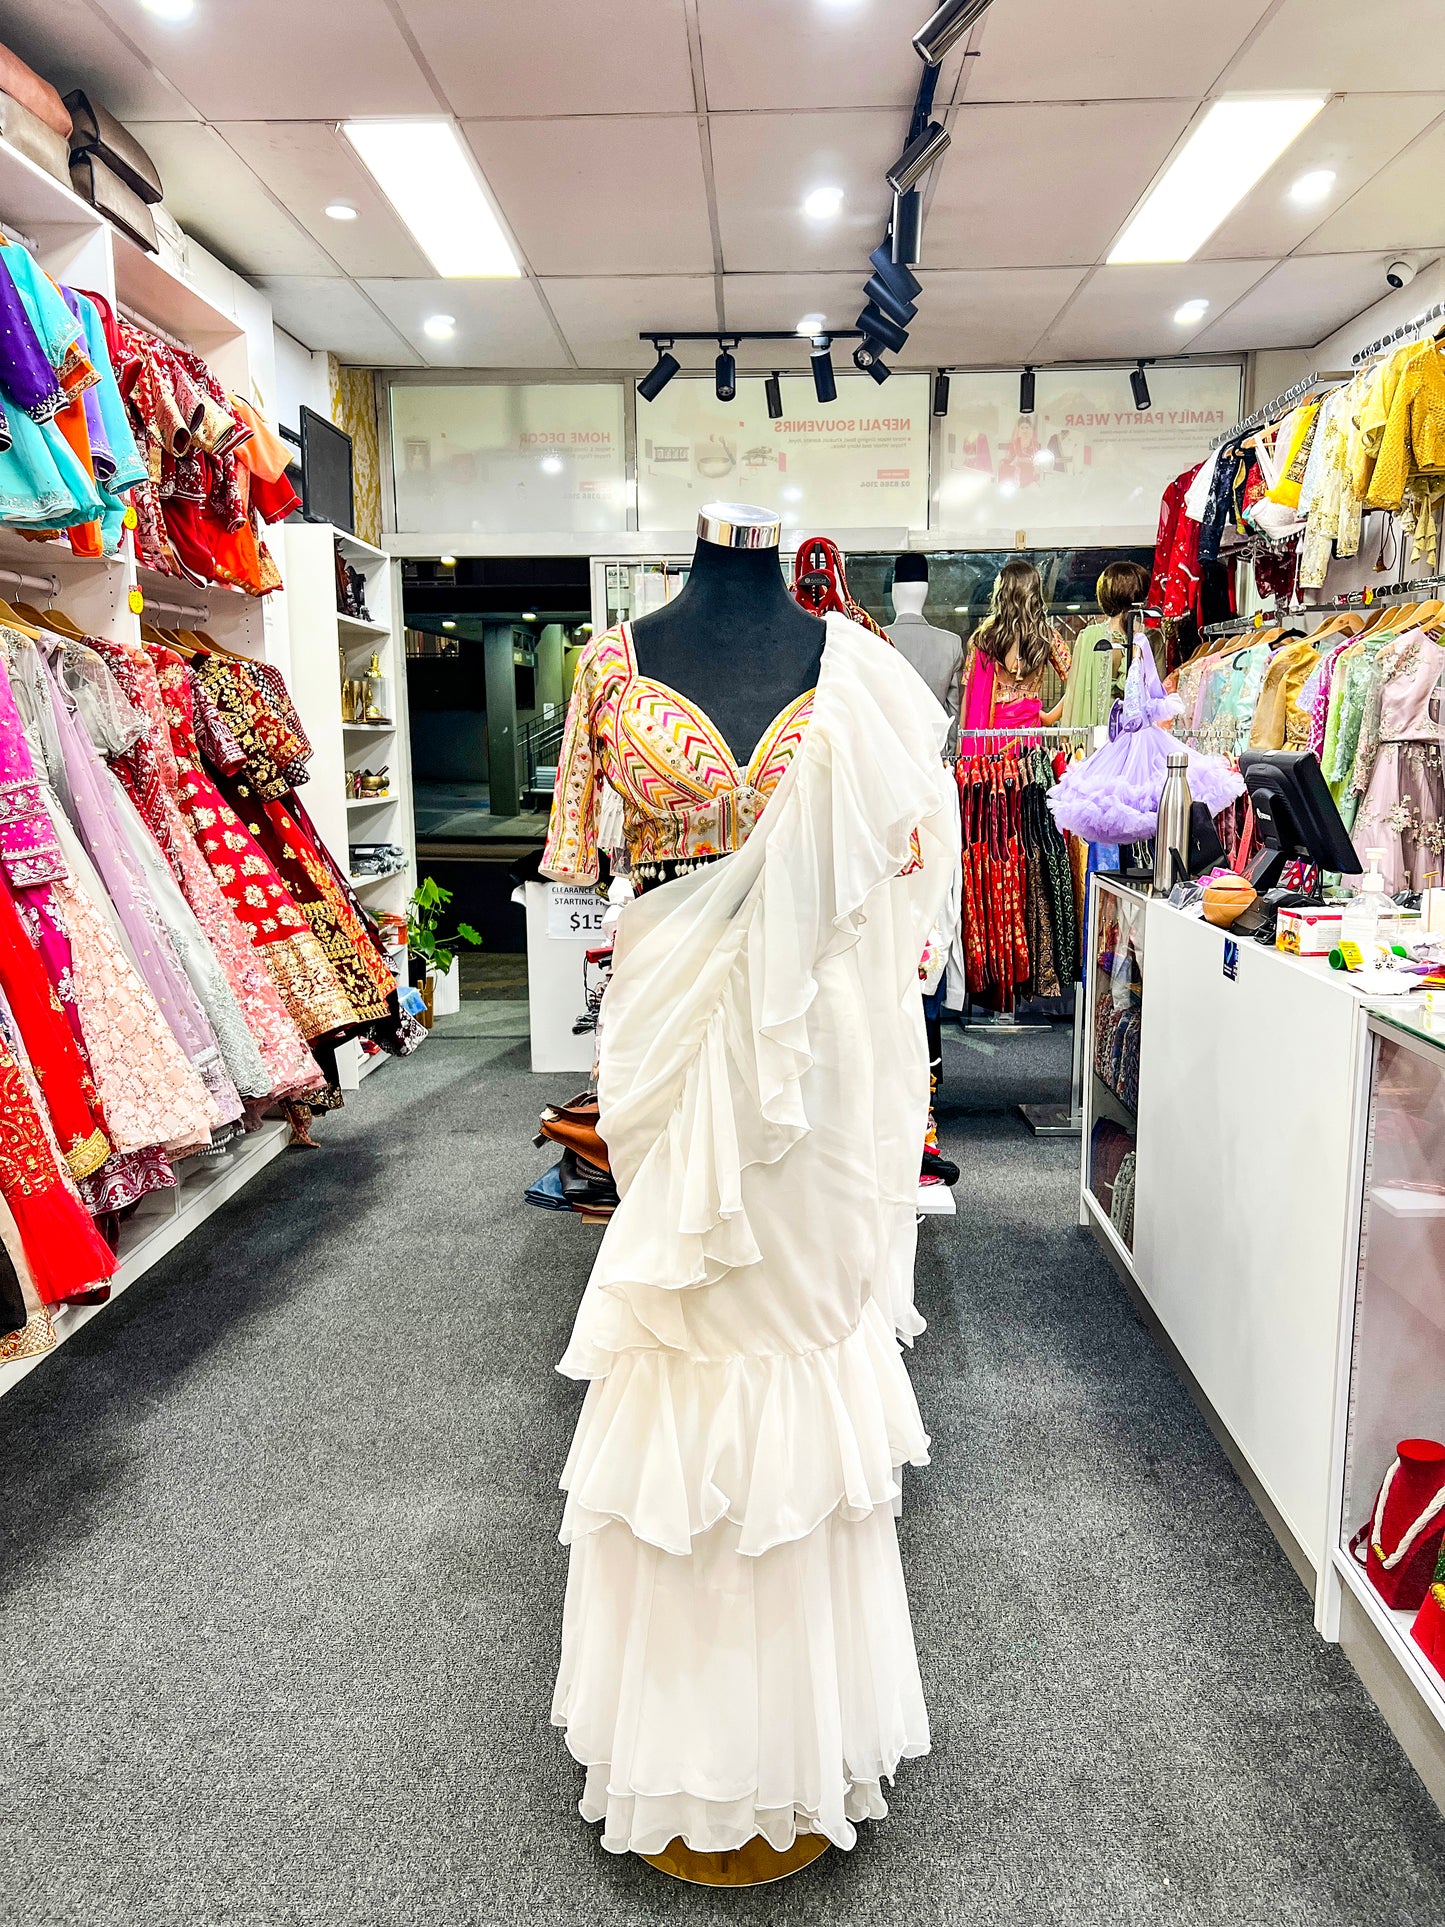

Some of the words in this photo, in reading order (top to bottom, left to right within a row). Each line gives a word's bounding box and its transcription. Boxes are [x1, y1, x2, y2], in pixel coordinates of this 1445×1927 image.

[551, 886, 593, 894] CLEARANCE
[554, 897, 594, 906] STARTING
[570, 911, 604, 932] $15
